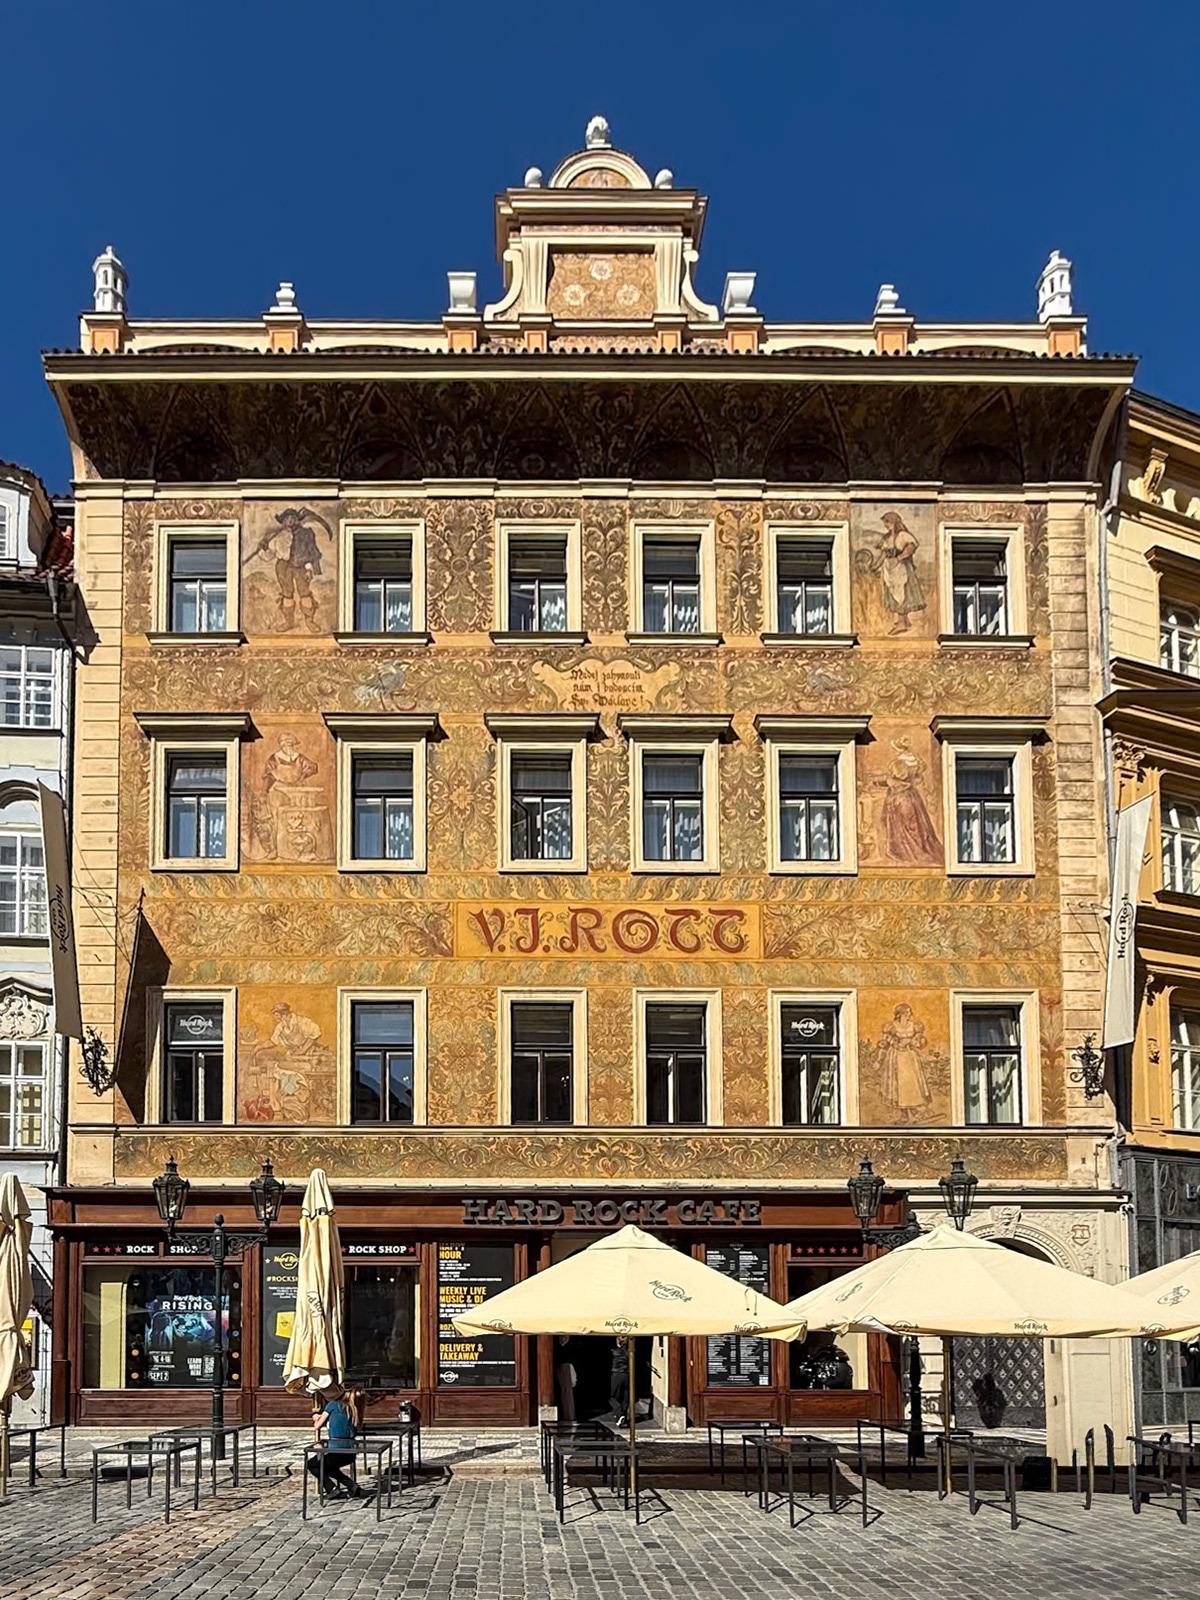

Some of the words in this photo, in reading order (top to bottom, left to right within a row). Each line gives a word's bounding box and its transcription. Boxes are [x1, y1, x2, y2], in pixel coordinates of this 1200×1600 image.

[462, 1200, 564, 1225] HARD
[572, 1200, 668, 1225] ROCK
[677, 1200, 762, 1225] CAFE
[126, 1245, 154, 1254] ROCK
[170, 1245, 198, 1254] SHOP
[349, 1245, 377, 1254] ROCK
[379, 1245, 407, 1254] SHOP
[439, 1251, 461, 1259] HOUR
[439, 1287, 467, 1295] WEEKLY
[470, 1287, 487, 1295] LIVE
[162, 1301, 213, 1310] RISING
[622, 1321, 639, 1329] Rock
[1032, 1323, 1048, 1331] Rock
[439, 1344, 475, 1352] DELIVERY
[478, 1344, 483, 1352] &
[439, 1352, 479, 1360] TAKEAWAY
